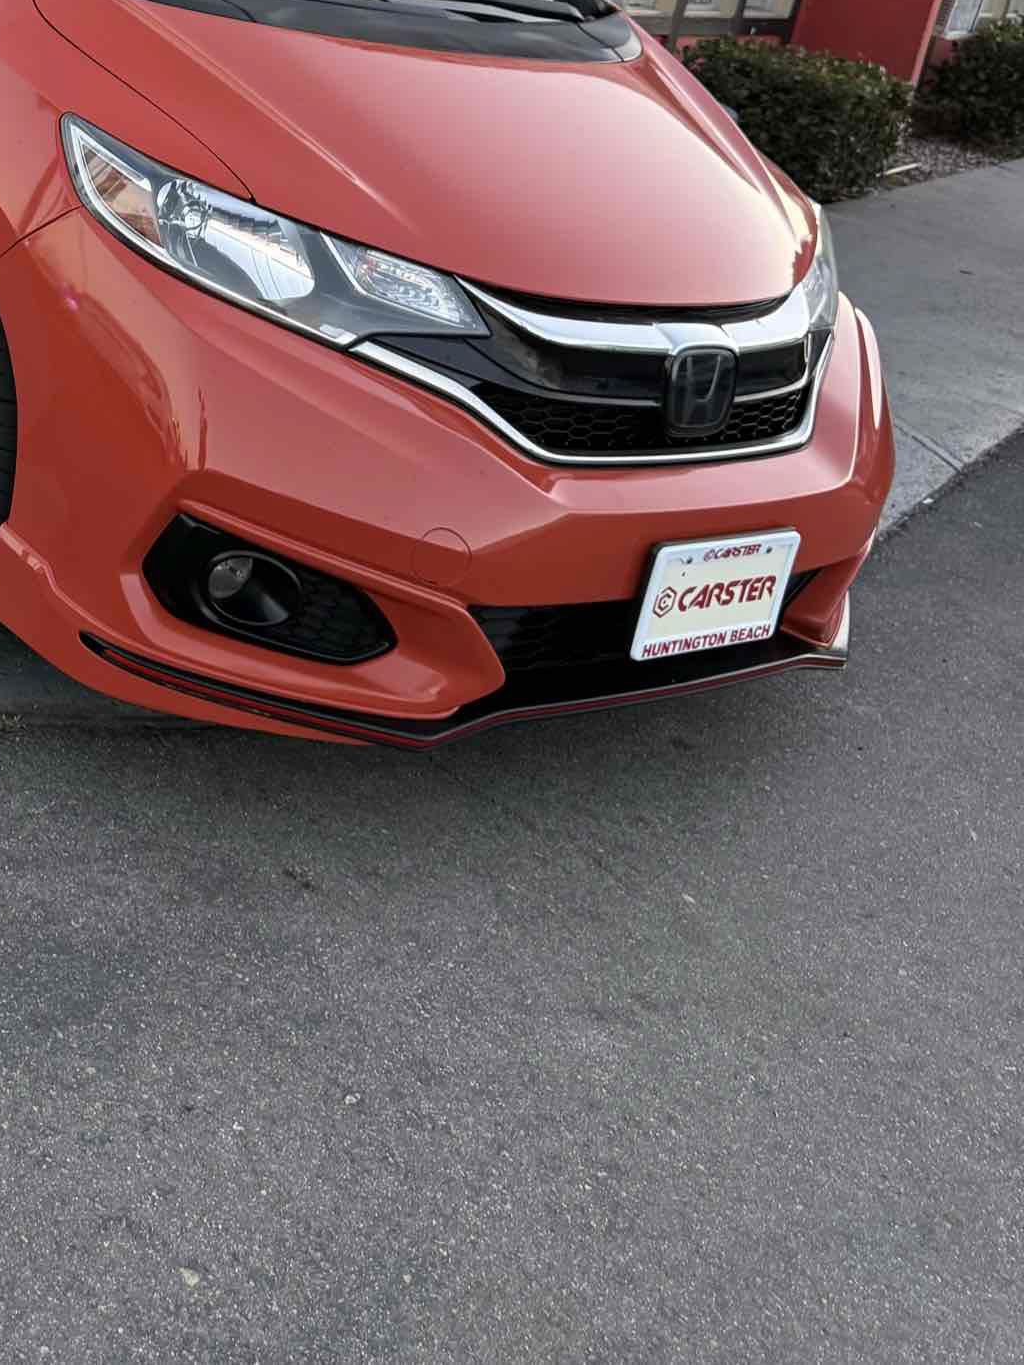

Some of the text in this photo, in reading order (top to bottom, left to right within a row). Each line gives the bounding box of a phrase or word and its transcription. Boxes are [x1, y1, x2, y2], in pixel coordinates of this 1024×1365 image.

[714, 543, 762, 561] CARSTER
[677, 575, 777, 613] CARSTER
[641, 624, 772, 658] HUNTINGTON BEACH
